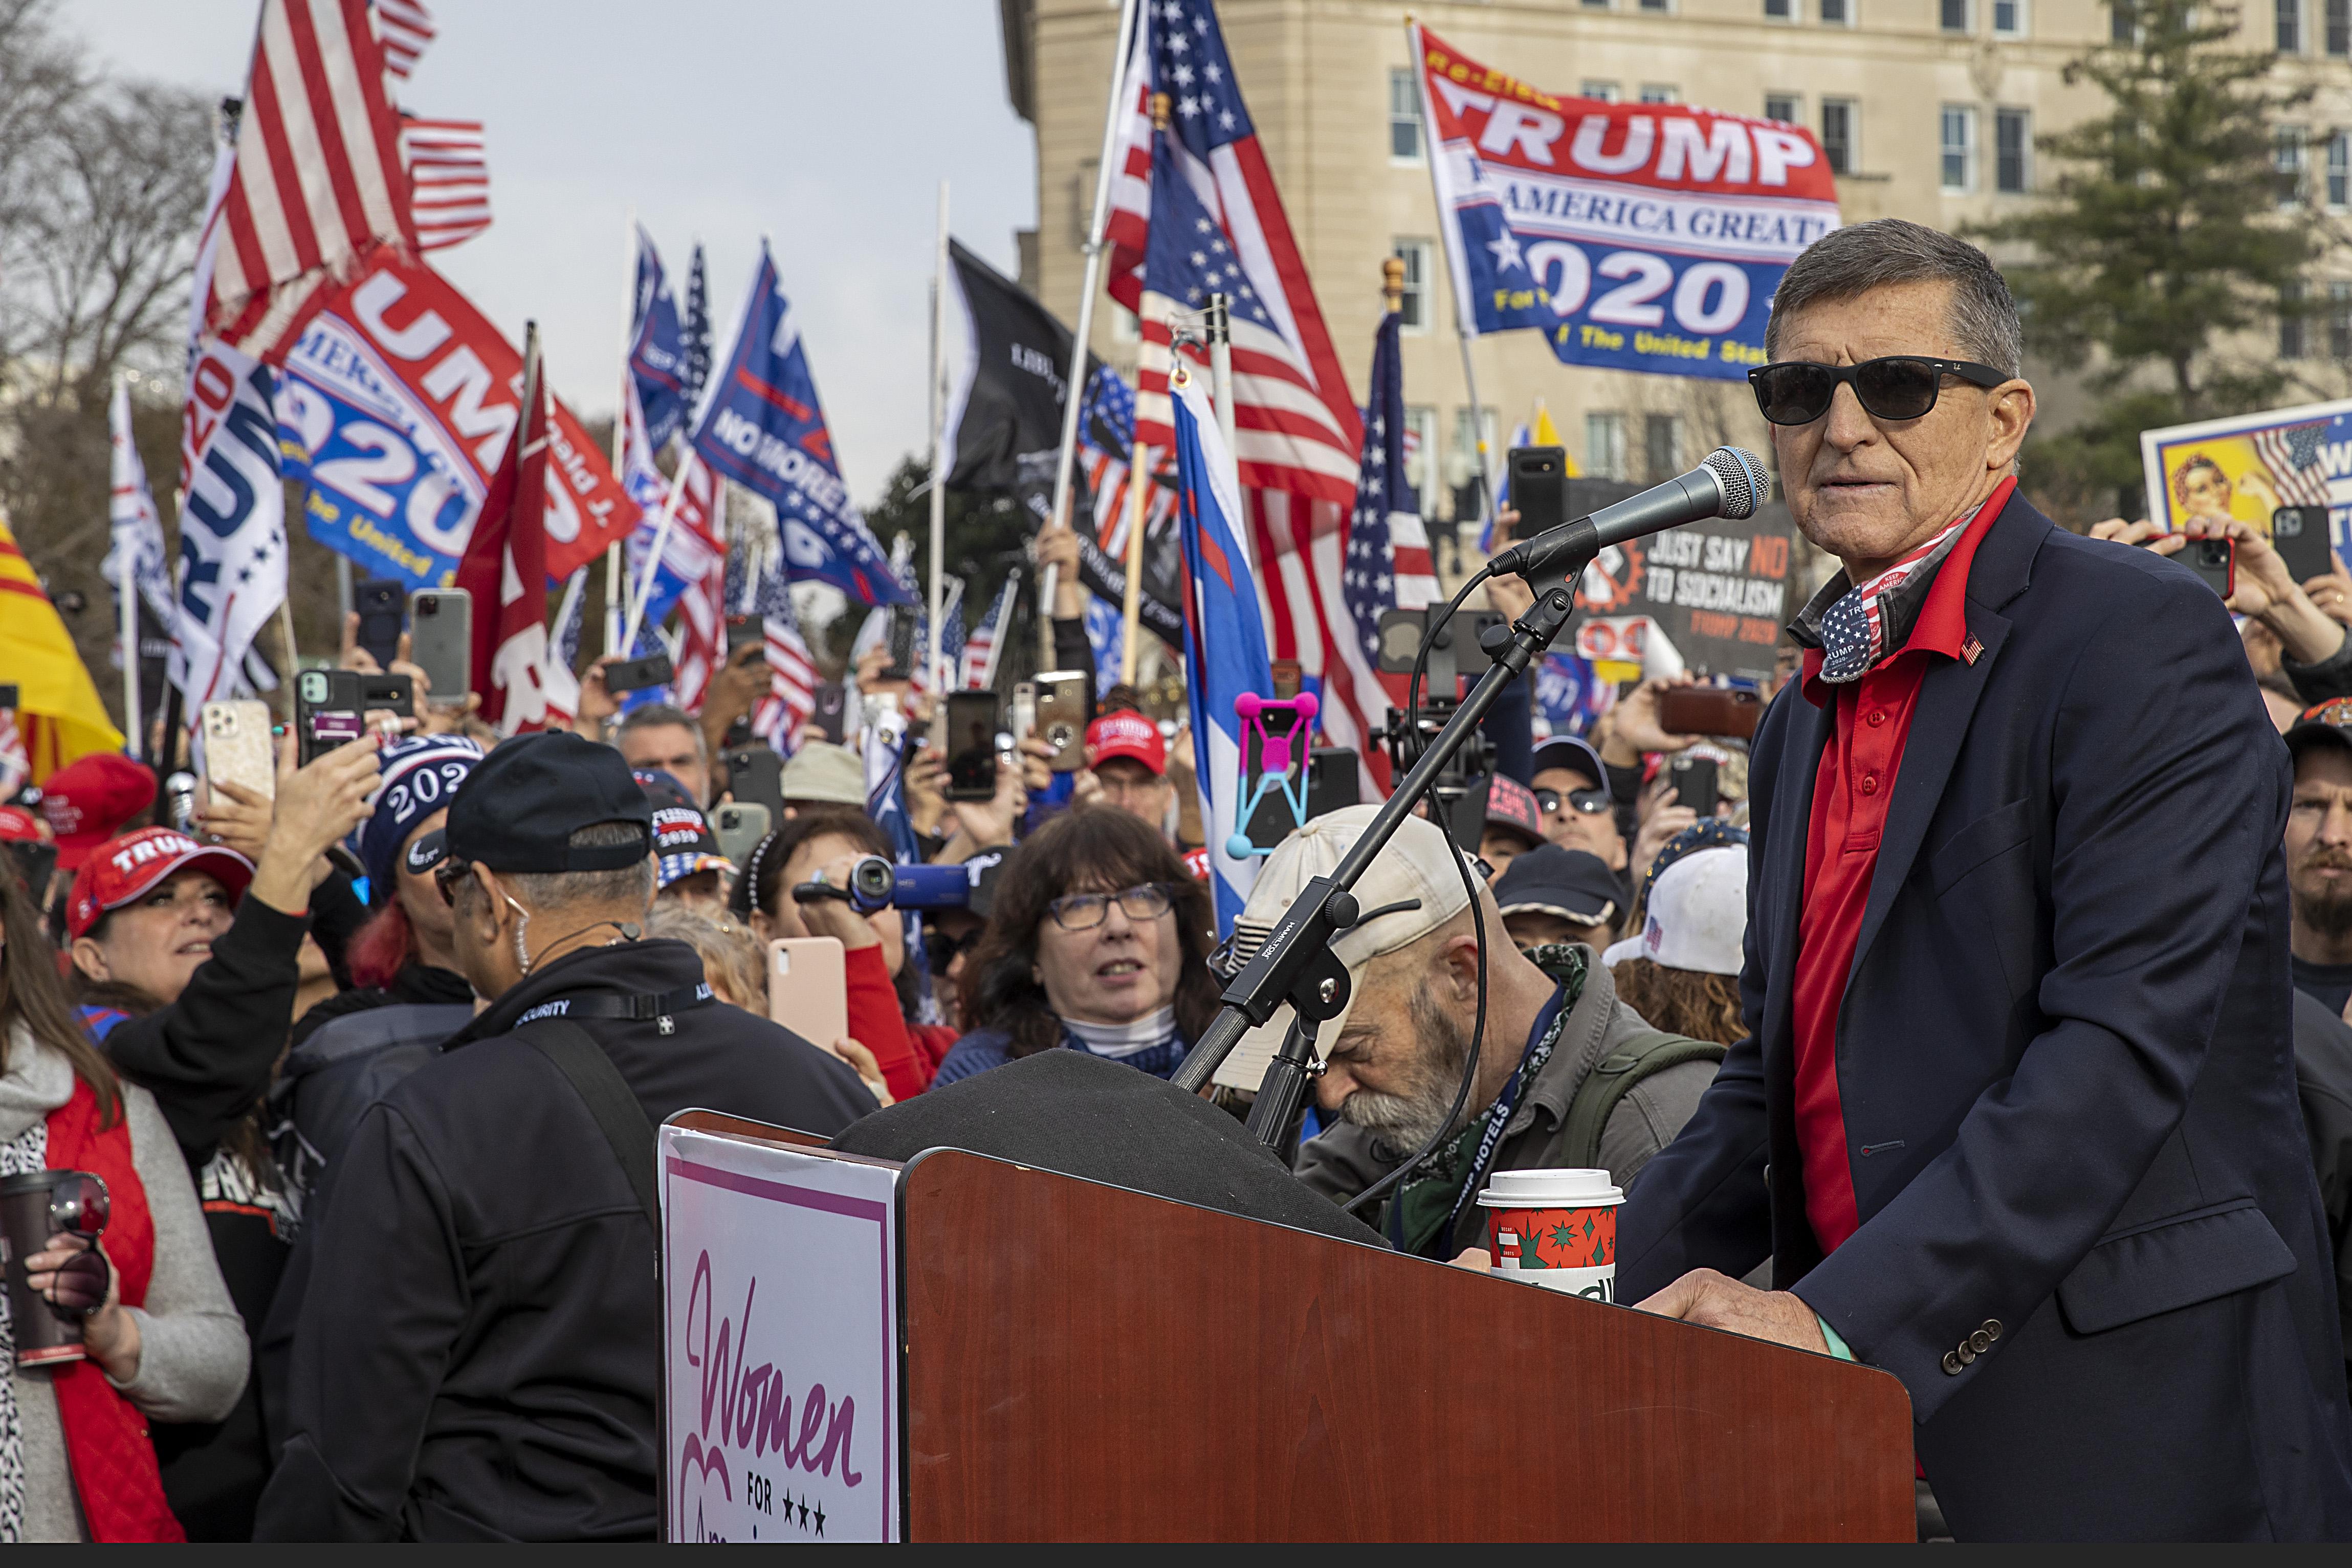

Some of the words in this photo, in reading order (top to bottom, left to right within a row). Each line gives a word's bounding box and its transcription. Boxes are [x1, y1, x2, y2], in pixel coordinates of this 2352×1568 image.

[1434, 74, 1816, 187] TRUMP
[1503, 182, 1677, 234] AMERICA
[1580, 324, 1624, 350] The
[1634, 330, 1711, 360] United
[713, 406, 762, 456] NO
[348, 514, 434, 578] United
[1647, 529, 1705, 569] JUST
[1703, 535, 1750, 573] SAY
[1748, 534, 1790, 580] NO
[1645, 566, 1675, 604] TO
[1674, 569, 1786, 619] SOCIALISM
[1884, 572, 1899, 582] KEEP
[1264, 921, 1296, 960] HAMILTON
[1473, 1103, 1509, 1172] HOTELS
[686, 1249, 863, 1487] Women
[748, 1470, 772, 1516] FOR
